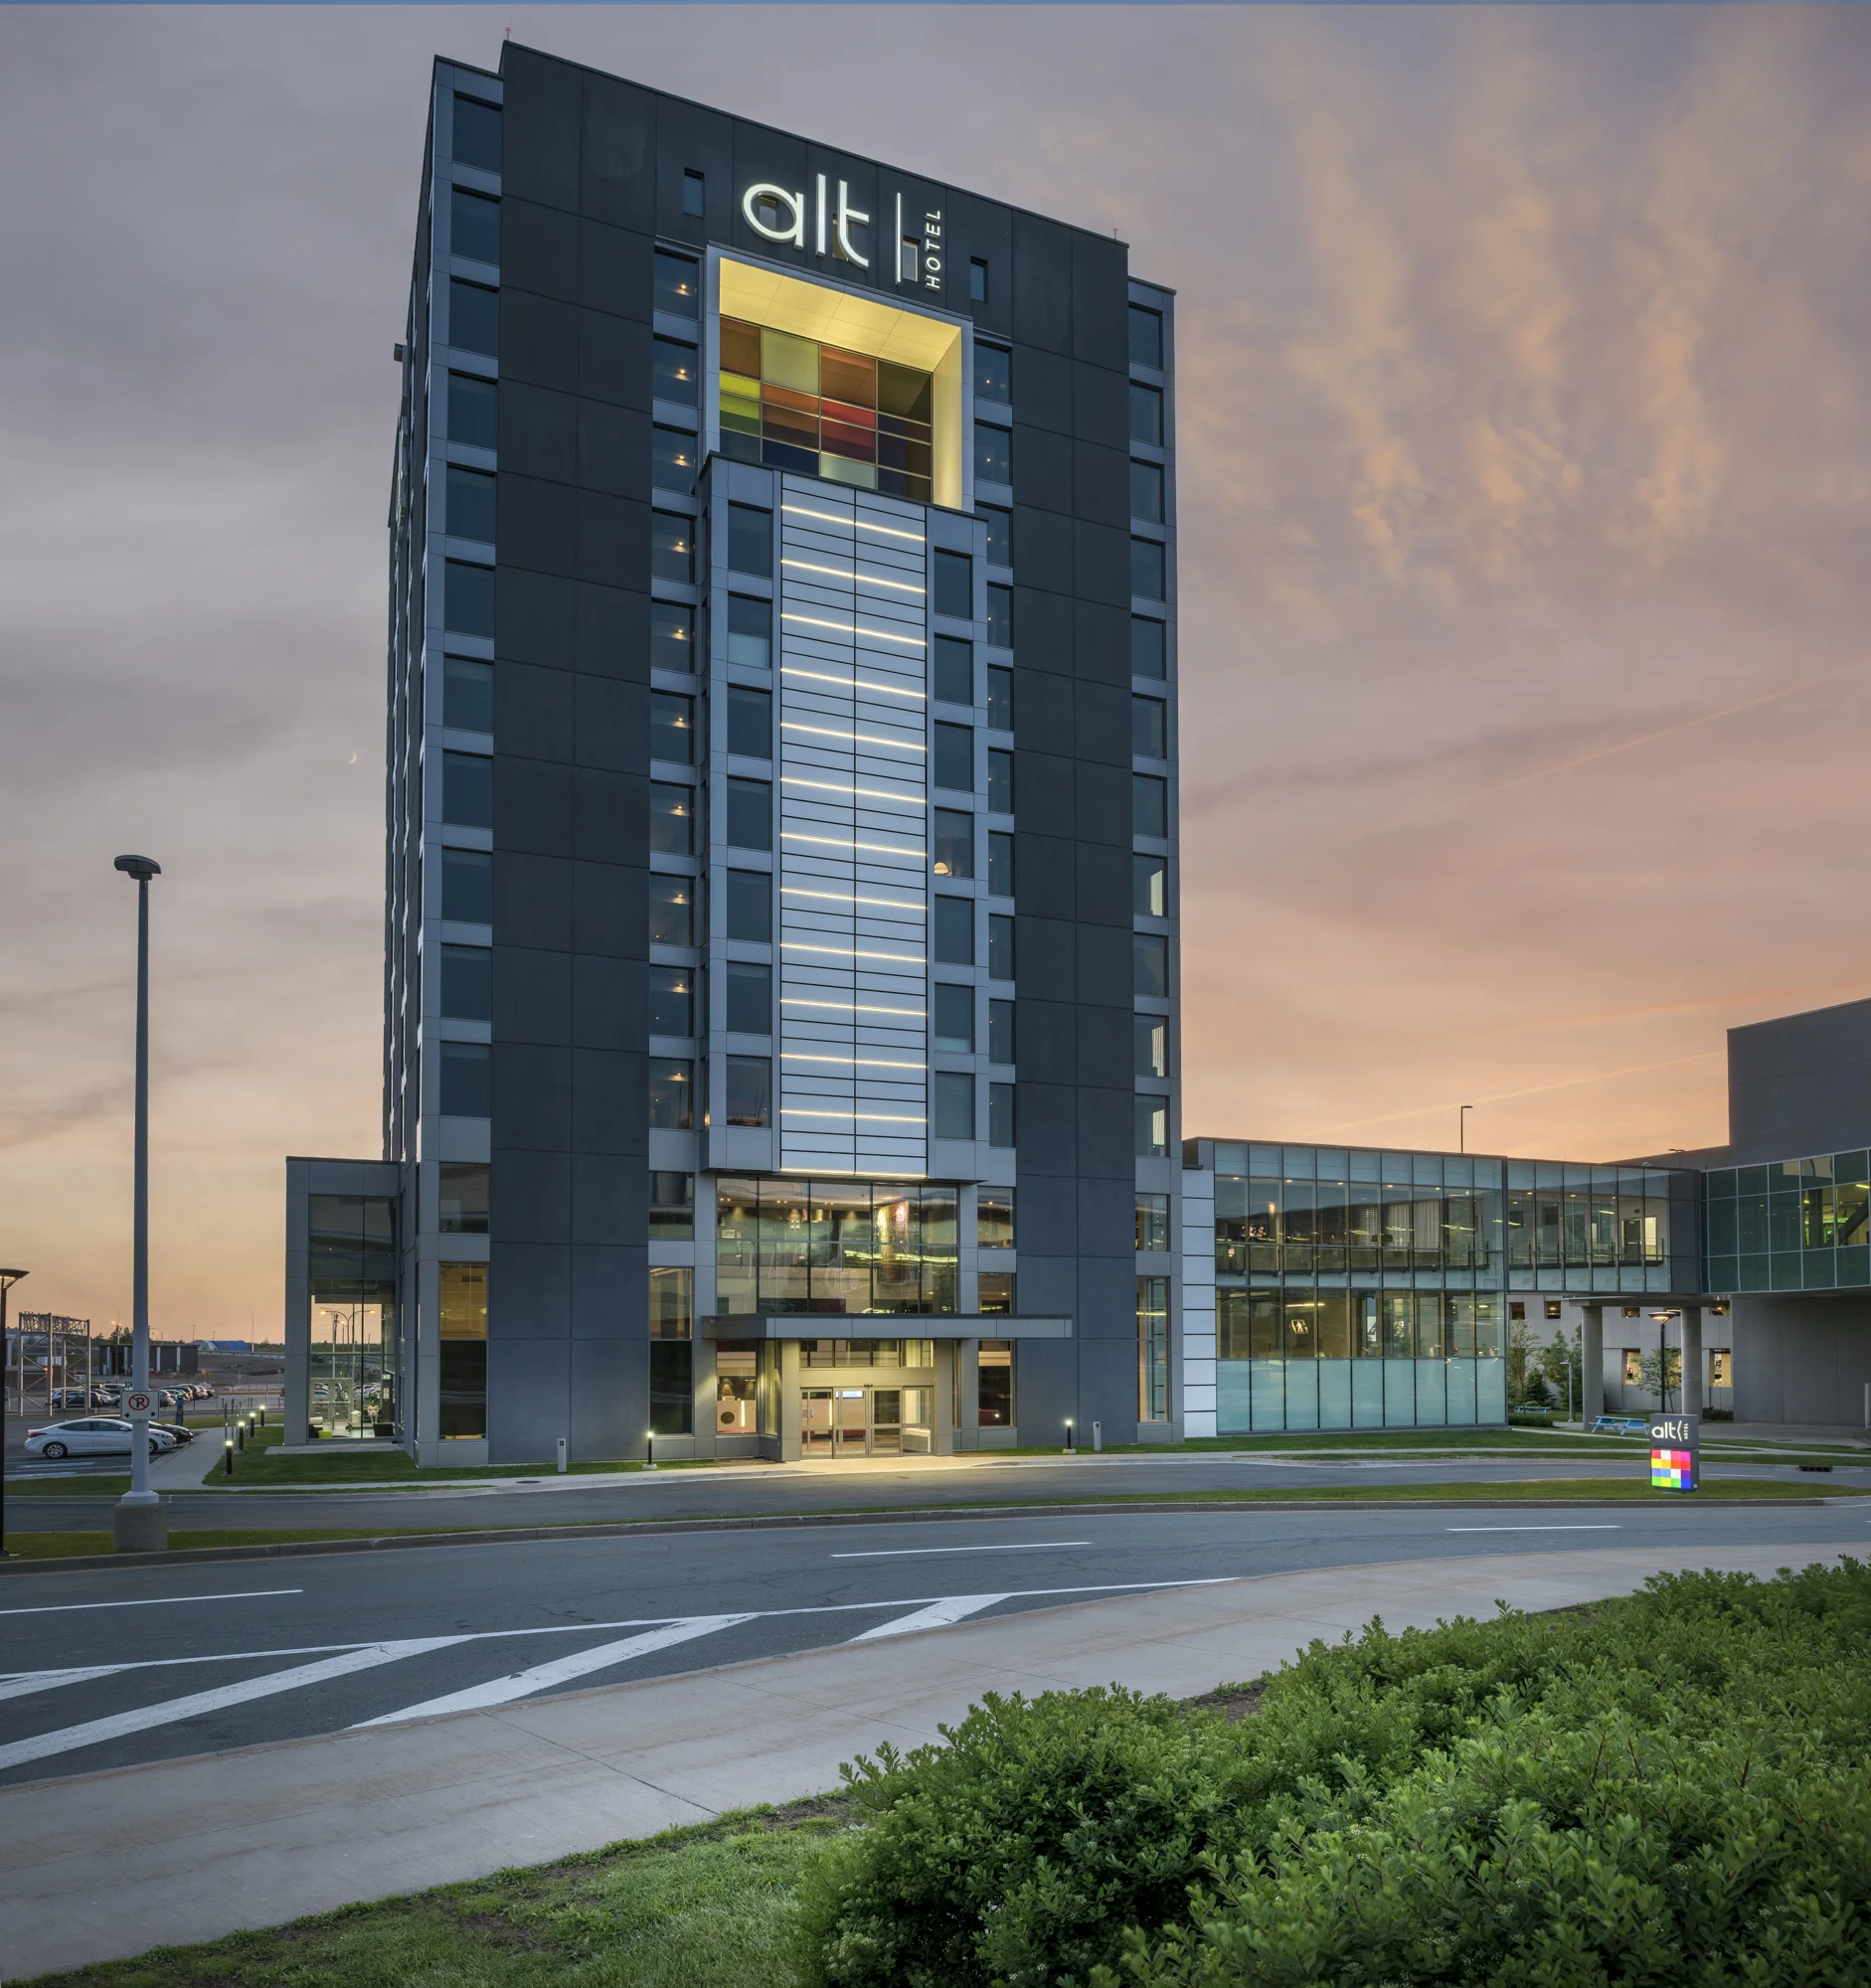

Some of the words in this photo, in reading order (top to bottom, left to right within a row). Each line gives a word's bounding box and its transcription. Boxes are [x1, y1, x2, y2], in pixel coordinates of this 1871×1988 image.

[742, 173, 870, 270] alt
[925, 210, 941, 290] HOTEL
[136, 1397, 145, 1408] P
[1651, 1422, 1676, 1439] alt
